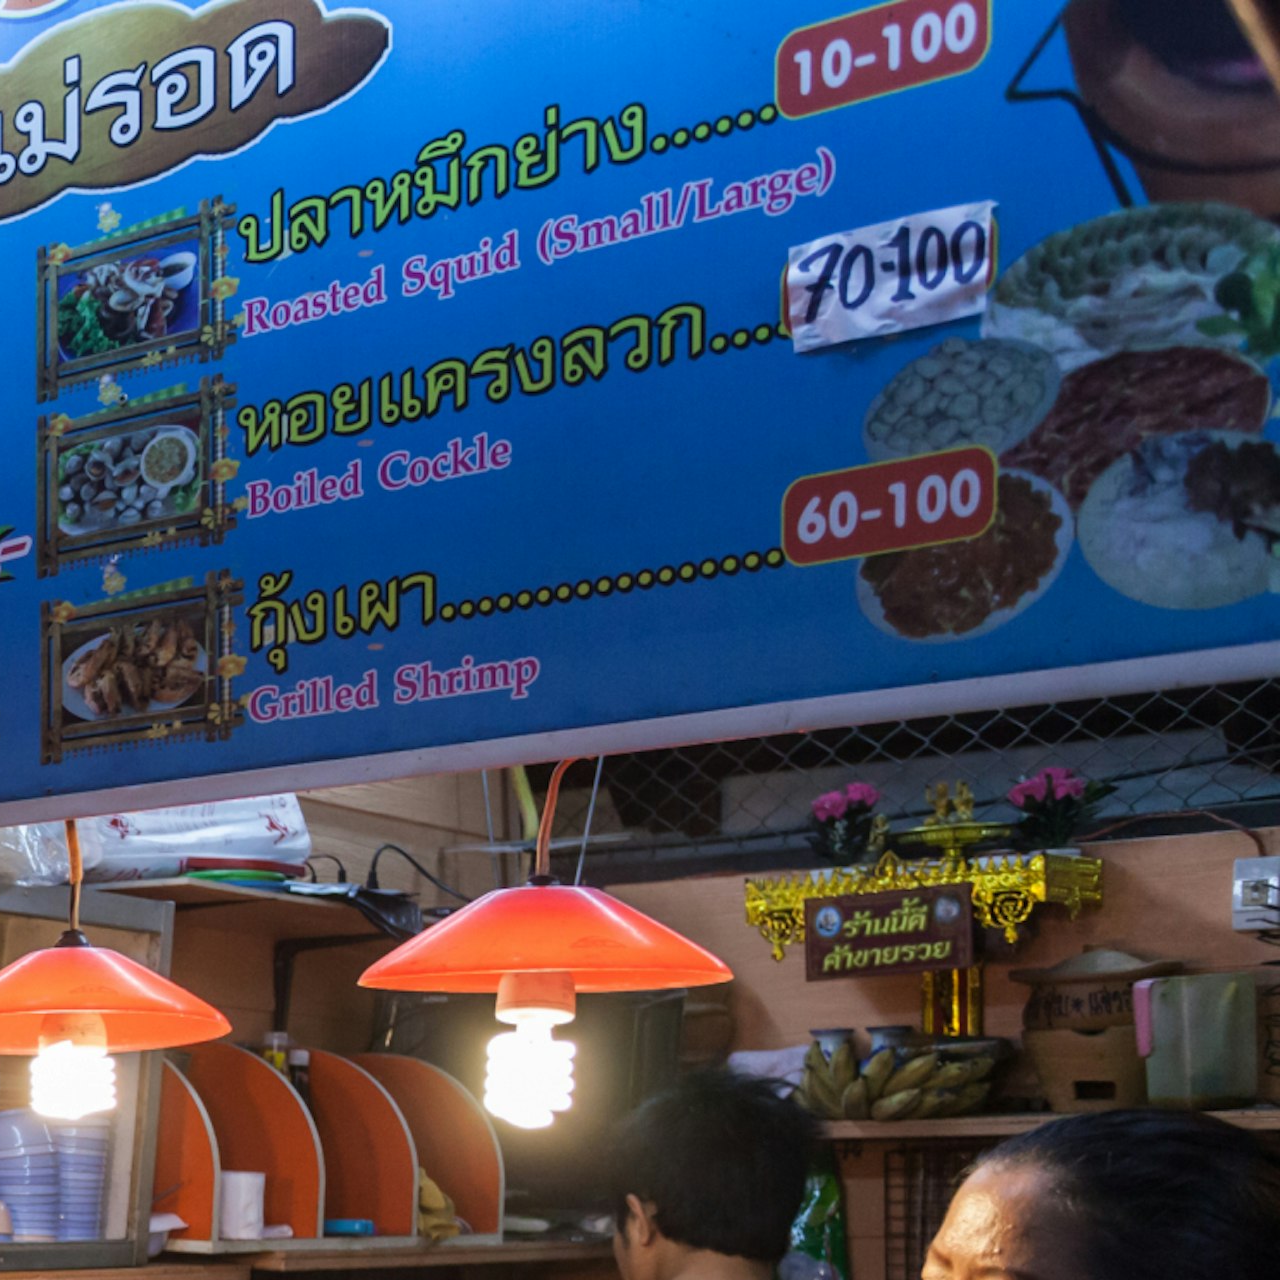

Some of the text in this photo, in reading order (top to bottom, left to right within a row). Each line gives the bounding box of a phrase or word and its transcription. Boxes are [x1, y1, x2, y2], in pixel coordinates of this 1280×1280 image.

[792, 4, 978, 97] 10-100
[241, 147, 837, 337] Roasted Squid (Small/Large)
[796, 219, 988, 325] 70-100
[246, 432, 512, 518] Boiled Cockle
[796, 468, 982, 544] 60-100
[248, 654, 540, 723] Grilled Shrimp
[822, 941, 952, 973] ค้าขายรวย
